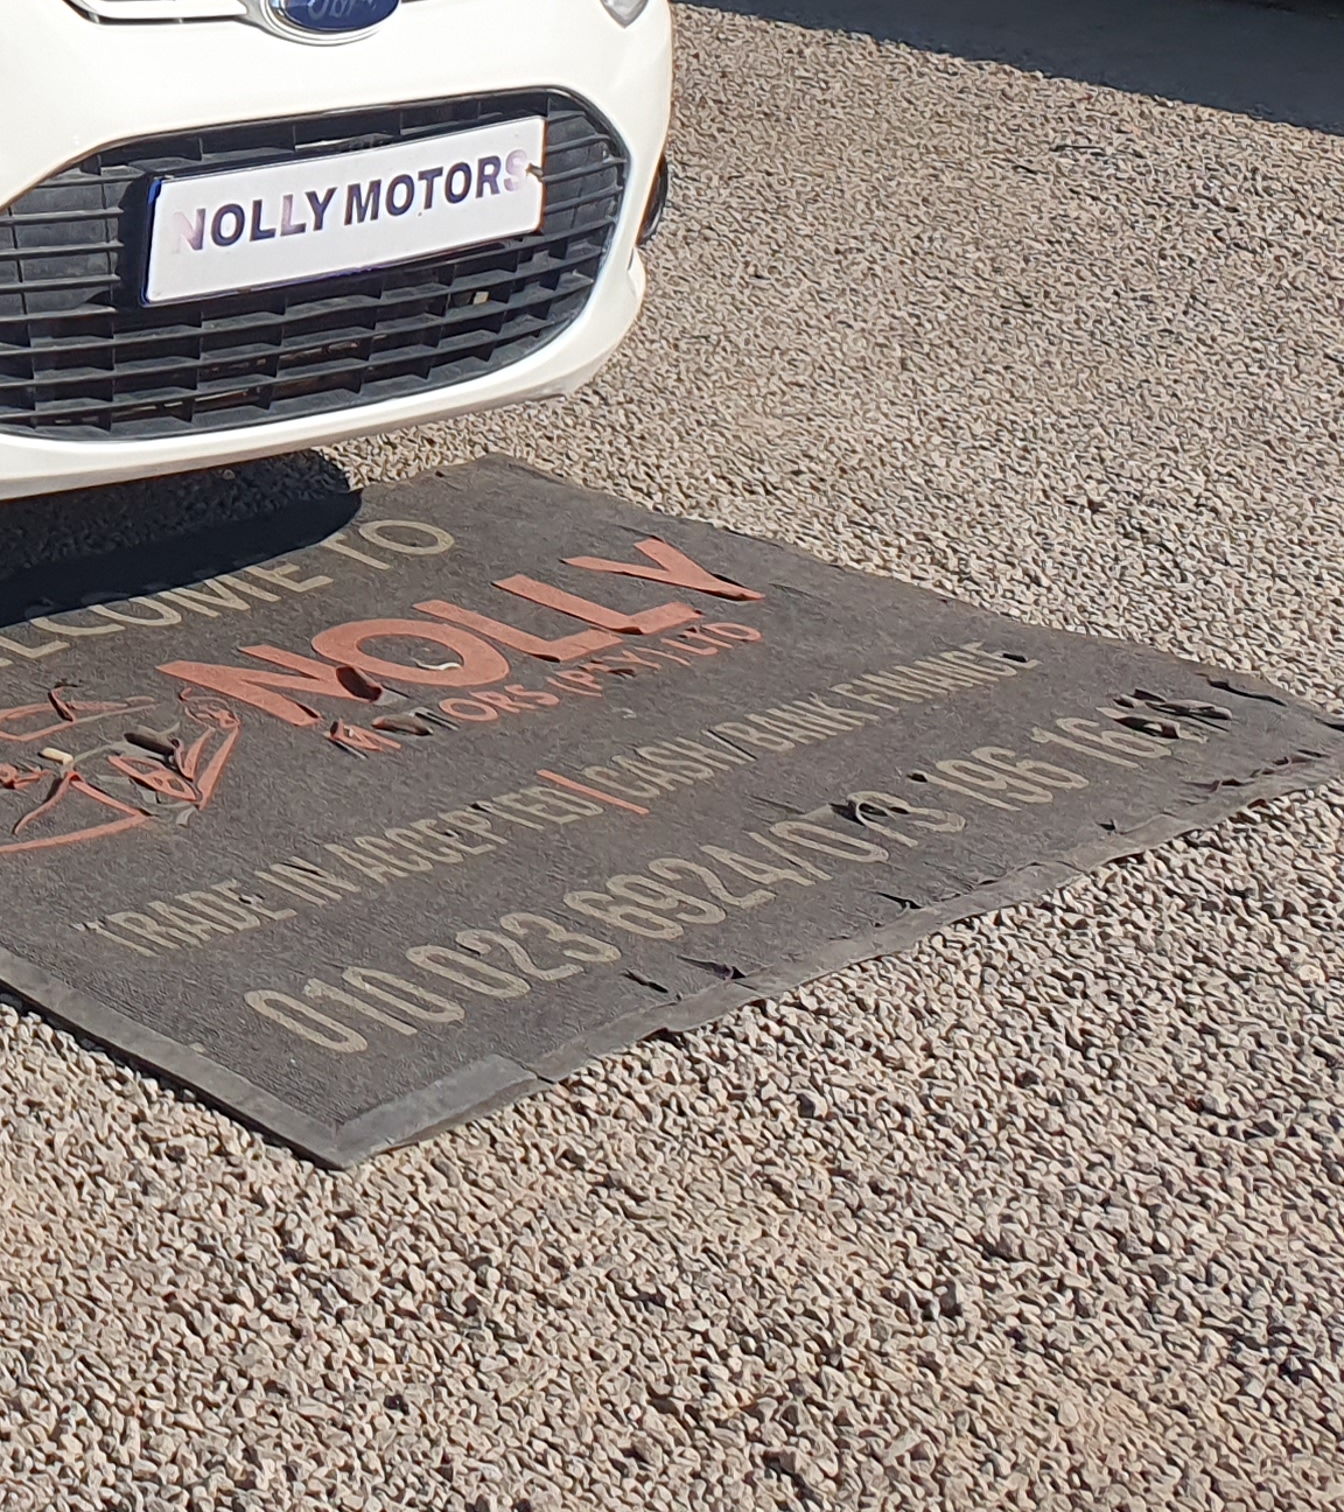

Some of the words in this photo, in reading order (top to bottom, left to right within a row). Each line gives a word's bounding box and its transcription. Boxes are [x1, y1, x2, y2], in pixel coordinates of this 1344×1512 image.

[172, 186, 338, 254] NOLLY
[343, 148, 528, 226] MOTORS
[156, 534, 765, 727] NOLLY
[320, 519, 455, 571] TO
[72, 878, 298, 958] TRADE
[253, 855, 362, 908] IN
[323, 786, 604, 885] ACCEPTED
[243, 966, 466, 1054] 010
[406, 912, 623, 999] 023
[909, 746, 1090, 812] 196
